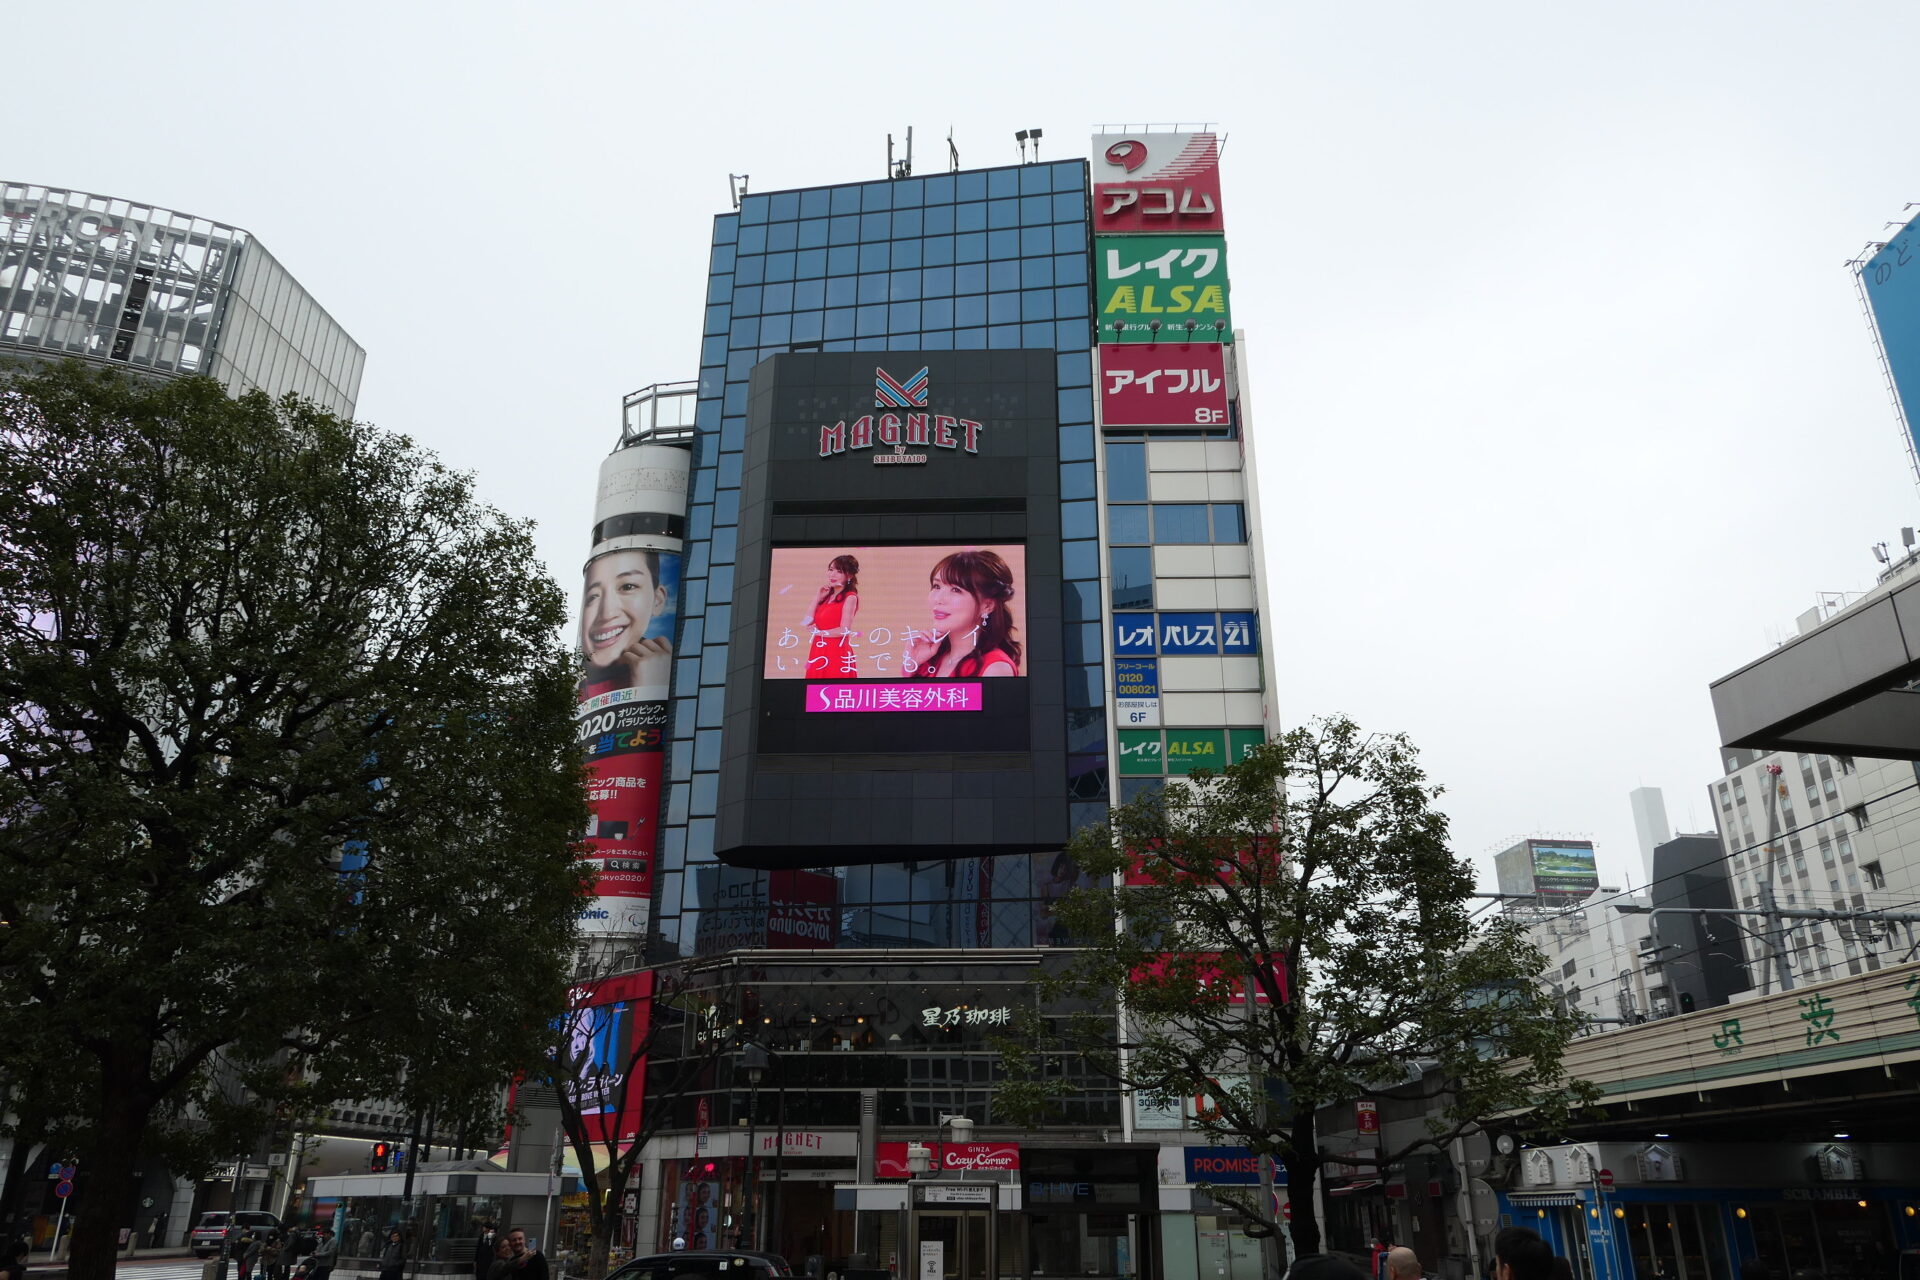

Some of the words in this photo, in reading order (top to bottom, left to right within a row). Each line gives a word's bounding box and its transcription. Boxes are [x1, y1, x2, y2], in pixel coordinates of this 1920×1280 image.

[1103, 187, 1216, 215] アコム
[1107, 249, 1219, 279] レイク
[1104, 285, 1225, 313] ALSA
[1106, 369, 1221, 394] アイフル
[1194, 407, 1223, 423] 8F
[819, 412, 982, 457] MAGNET
[873, 454, 927, 464] SHIBUYA109
[894, 445, 906, 455] by
[777, 624, 980, 650] あなたのキレイ
[776, 650, 937, 675] いつまでも。
[1118, 673, 1143, 682] 0120
[834, 687, 969, 710] 品川美容外科
[1119, 685, 1156, 695] 008021
[616, 716, 668, 729] パラリンピック
[1130, 712, 1147, 723] 6F
[1119, 741, 1161, 755] レイク
[1168, 741, 1216, 755] ALSA
[921, 1005, 1012, 1027] 星乃珈琲
[1712, 1018, 1744, 1049] JR
[945, 1152, 977, 1170] Cozy
[976, 1153, 1012, 1166] Corner
[1193, 1157, 1259, 1174] PROMISE
[1783, 1188, 1861, 1200] SCRAMBLE
